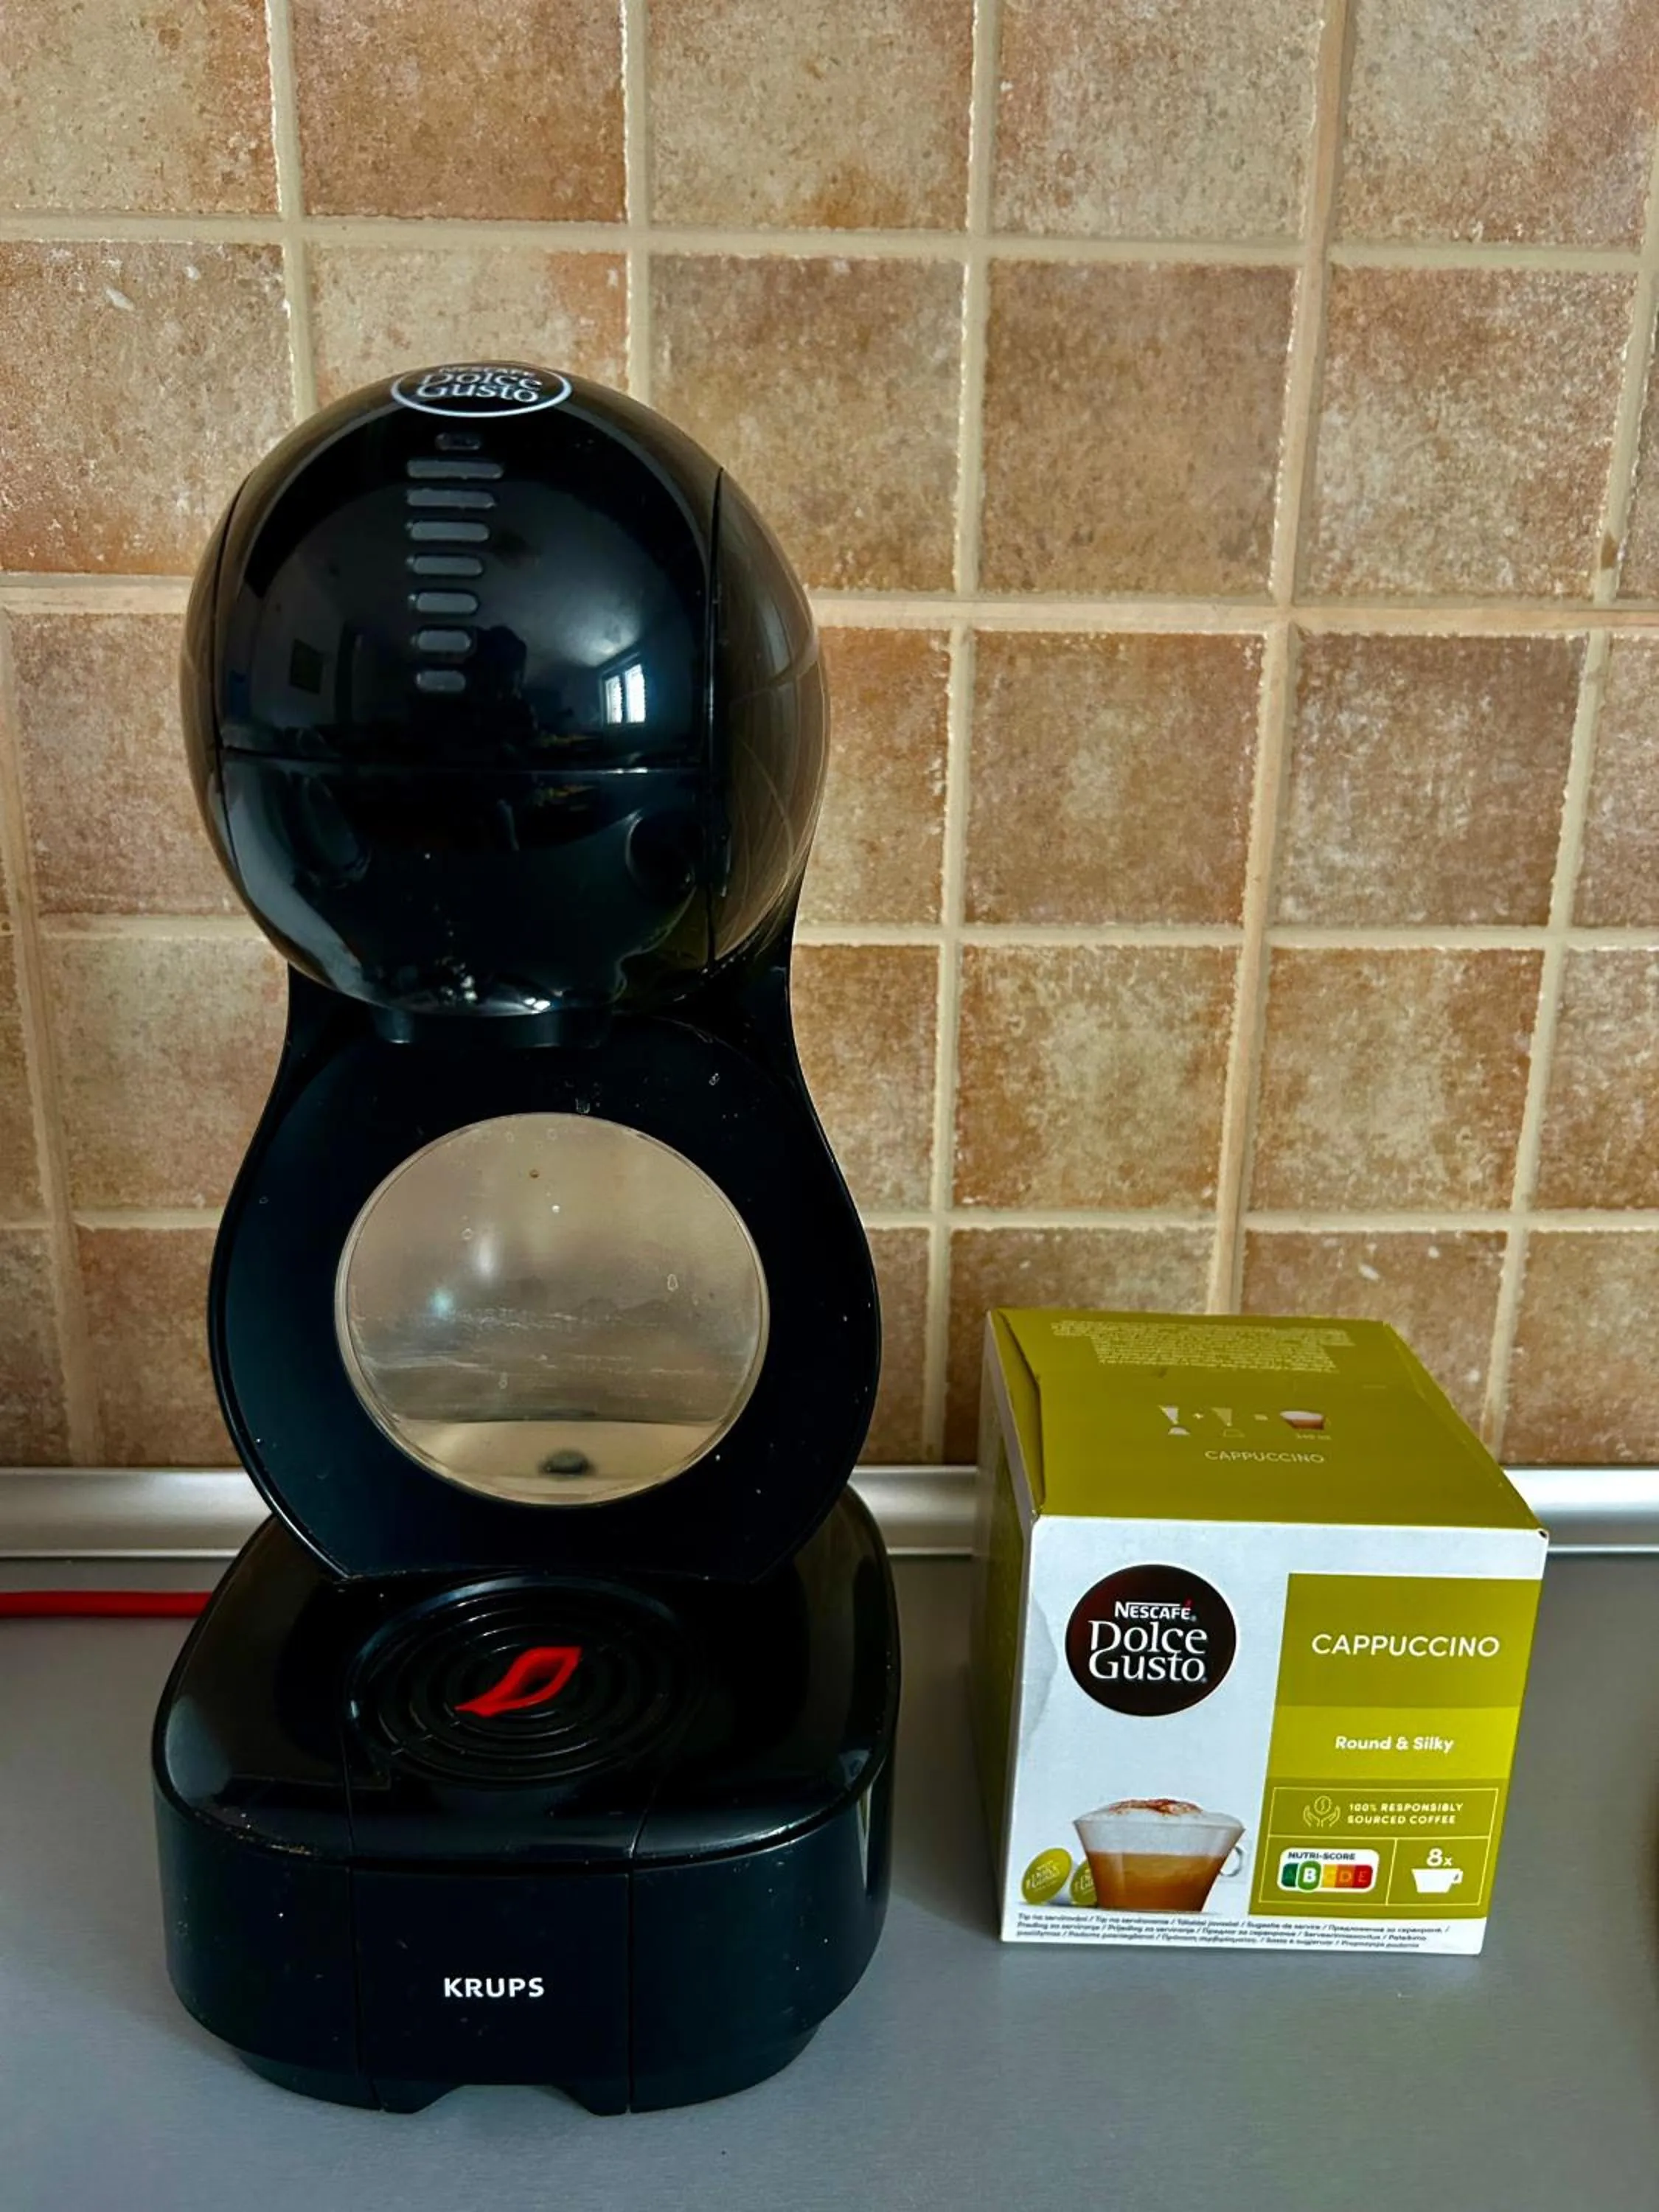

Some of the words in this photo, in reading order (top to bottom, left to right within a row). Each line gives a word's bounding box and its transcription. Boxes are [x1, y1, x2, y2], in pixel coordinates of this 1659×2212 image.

[423, 372, 543, 390] Dolce
[416, 383, 539, 403] Gusto
[1204, 1450, 1325, 1464] CAPPUCCINO
[1088, 1620, 1208, 1654] Dolce
[1311, 1633, 1500, 1658] CAPPUCCINO
[1089, 1649, 1206, 1682] Gusto
[1335, 1736, 1391, 1750] Round
[1396, 1736, 1409, 1751] &
[1413, 1736, 1454, 1754] Silky
[1349, 1803, 1377, 1812] 100%
[1380, 1803, 1464, 1812] RESPONSIBLY
[1347, 1815, 1406, 1824] SOURCED
[1409, 1815, 1456, 1824] COFFEE
[1288, 1851, 1357, 1860] NUTRI-SCORE
[1303, 1866, 1317, 1884] B
[444, 1977, 545, 1998] KRUPS
